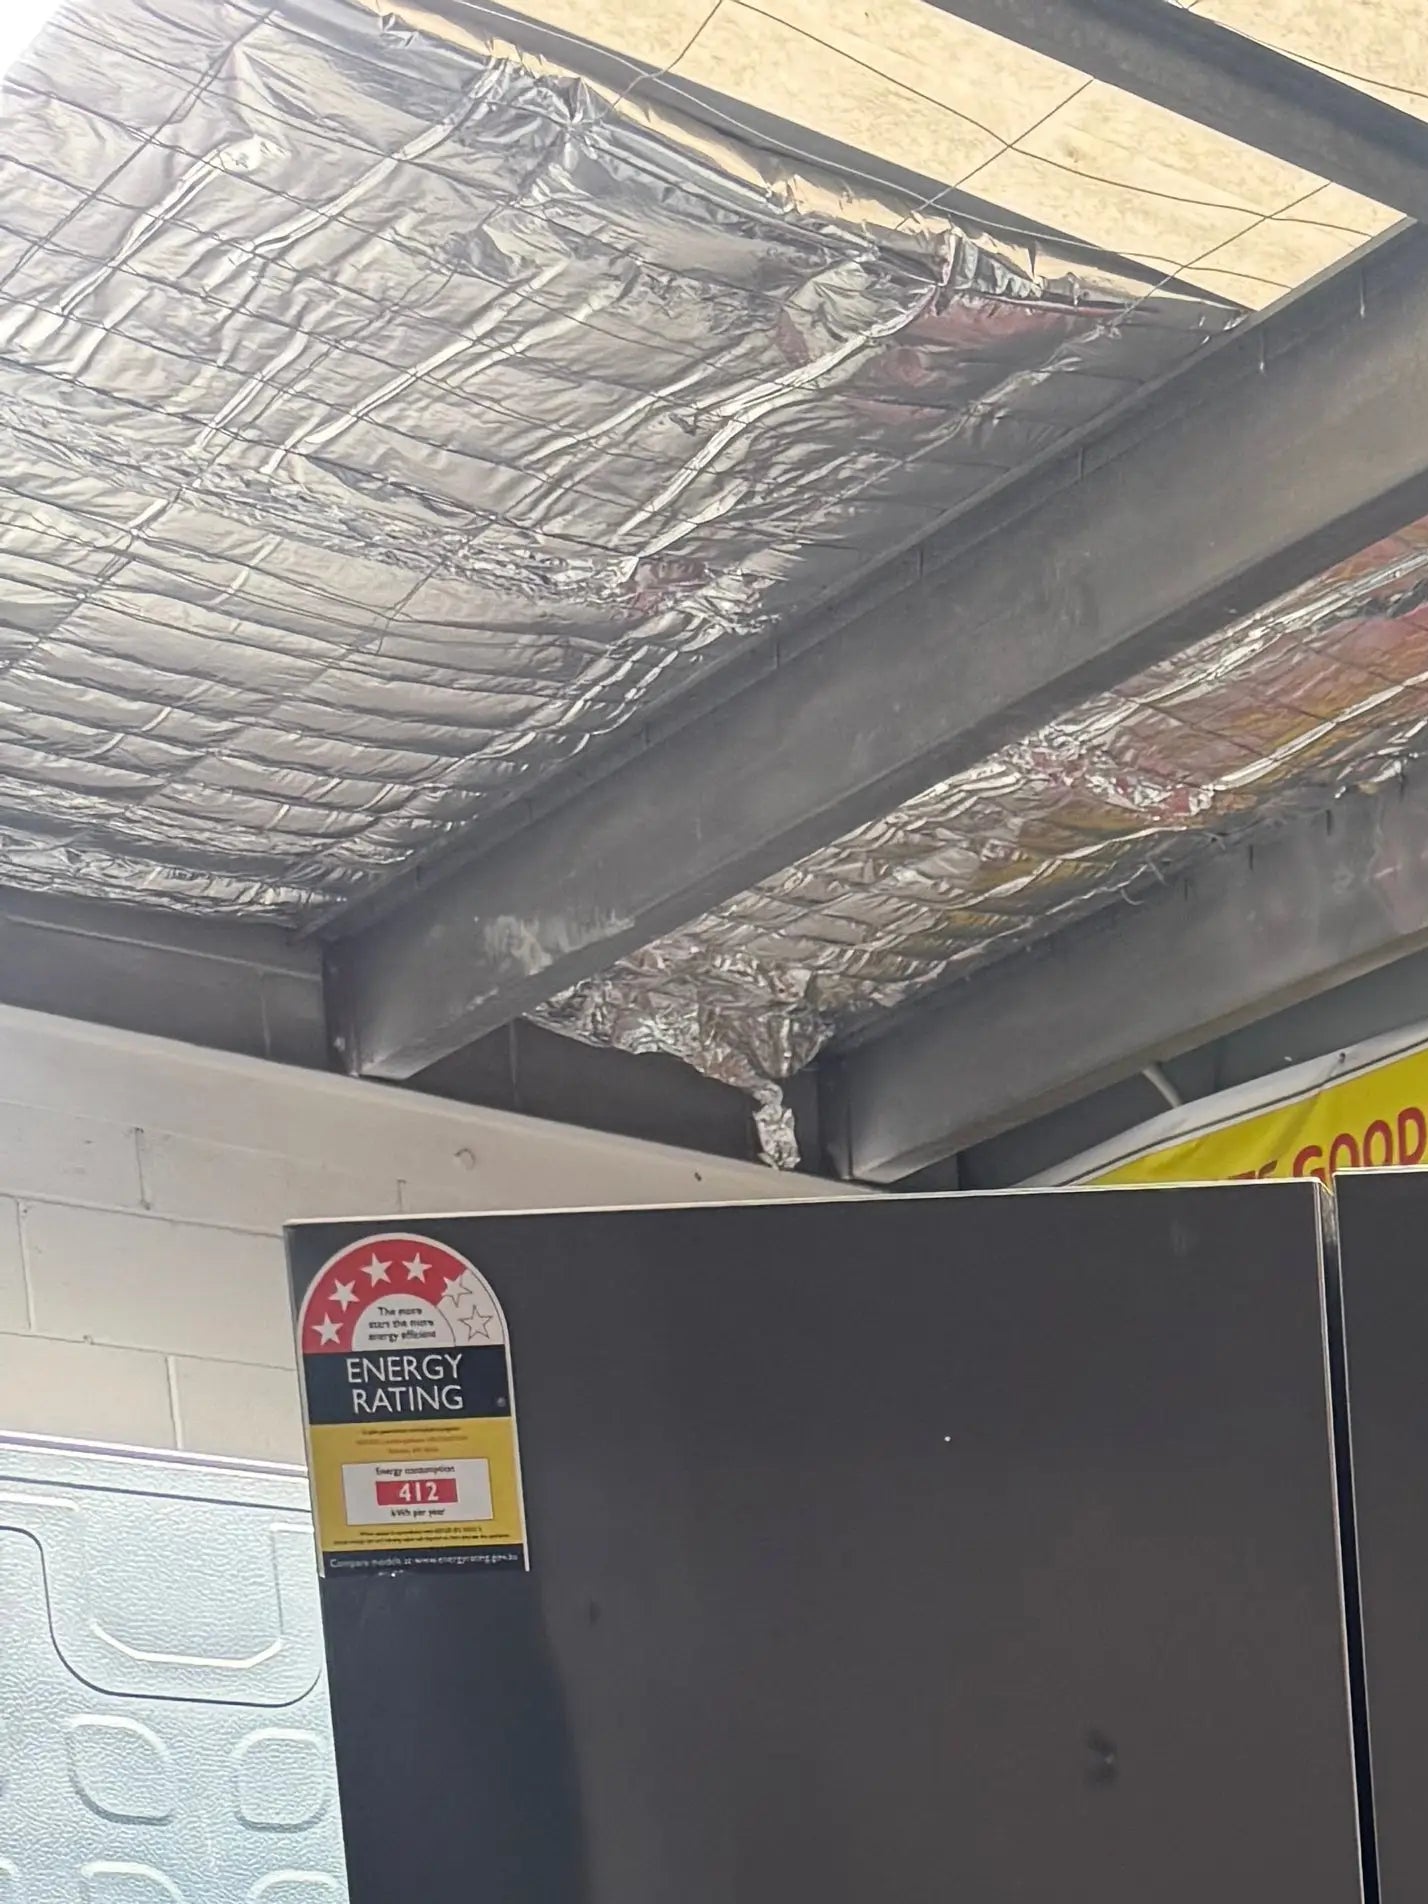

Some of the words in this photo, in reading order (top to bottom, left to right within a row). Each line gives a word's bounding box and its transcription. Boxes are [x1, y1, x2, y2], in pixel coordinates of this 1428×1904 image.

[346, 1354, 463, 1383] ENERGY
[352, 1385, 464, 1414] RATING
[375, 1467, 402, 1477] Energy
[398, 1481, 439, 1502] 412
